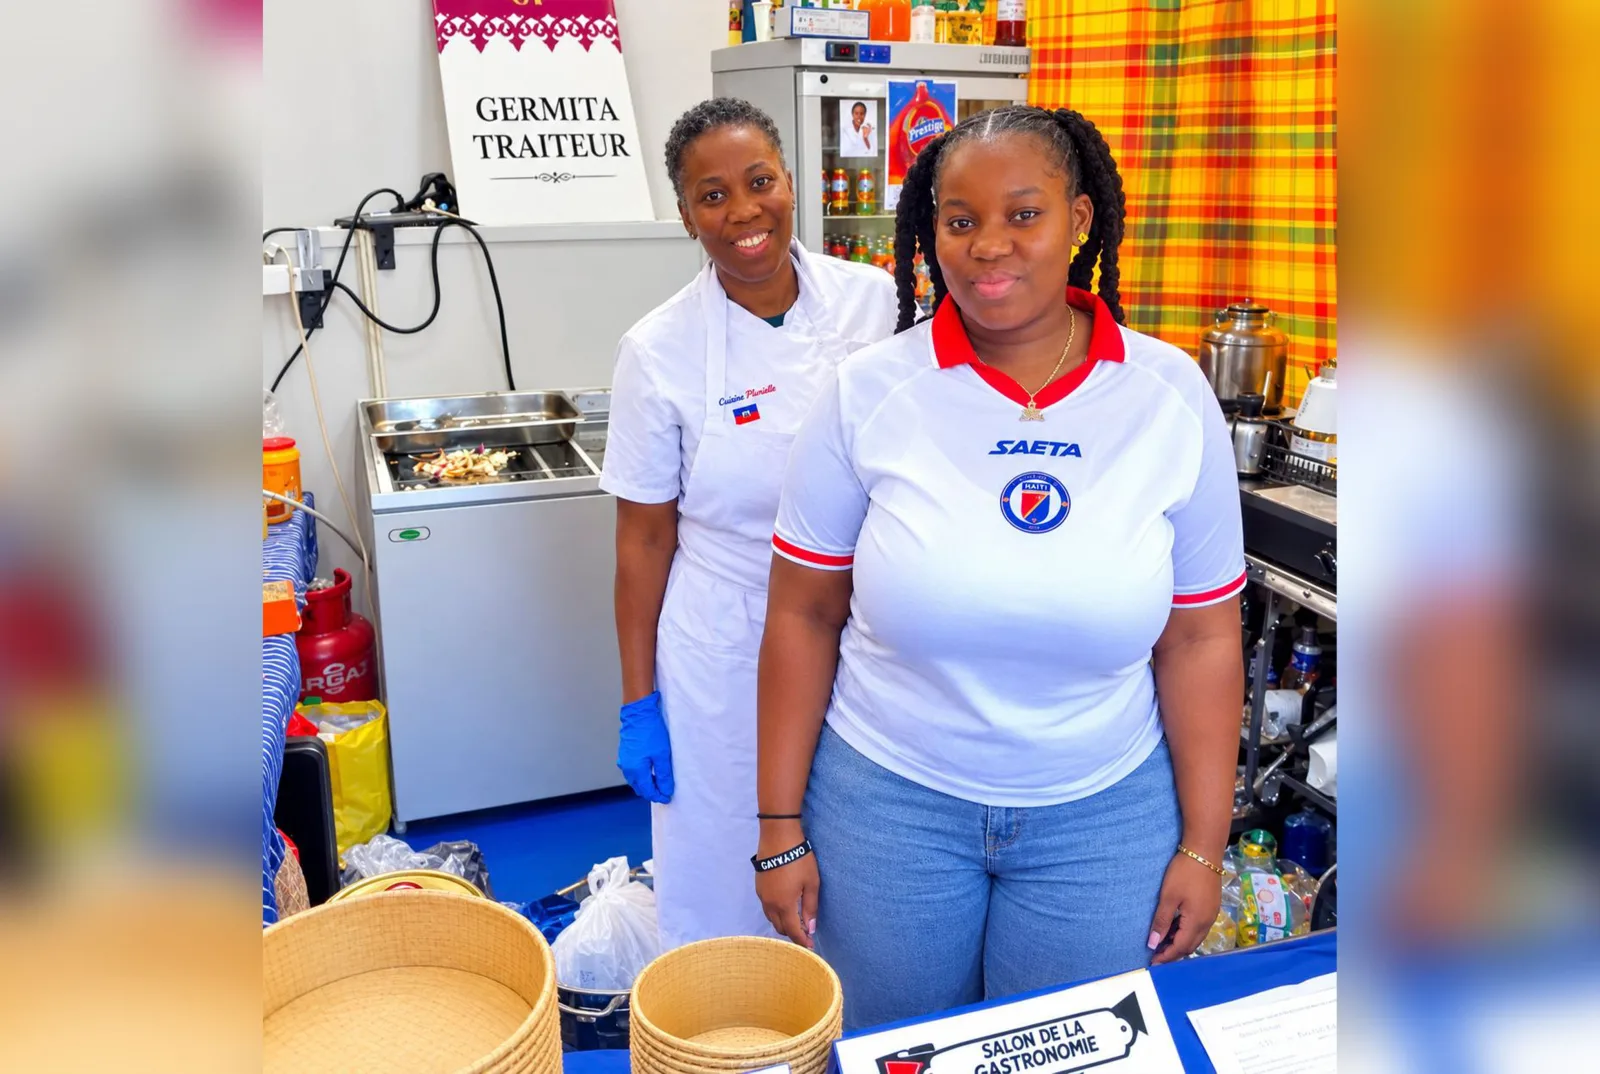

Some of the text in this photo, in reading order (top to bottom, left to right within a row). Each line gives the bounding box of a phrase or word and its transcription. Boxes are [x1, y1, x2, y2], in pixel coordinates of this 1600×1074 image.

[475, 96, 620, 122] GERMITA
[908, 120, 944, 141] Prestige
[472, 133, 631, 159] TRAITEUR
[718, 394, 745, 406] Cuisine
[988, 440, 1082, 458] SAETA
[982, 1020, 1086, 1059] SALON DE LA
[974, 1035, 1099, 1074] GASTRONOMIE
